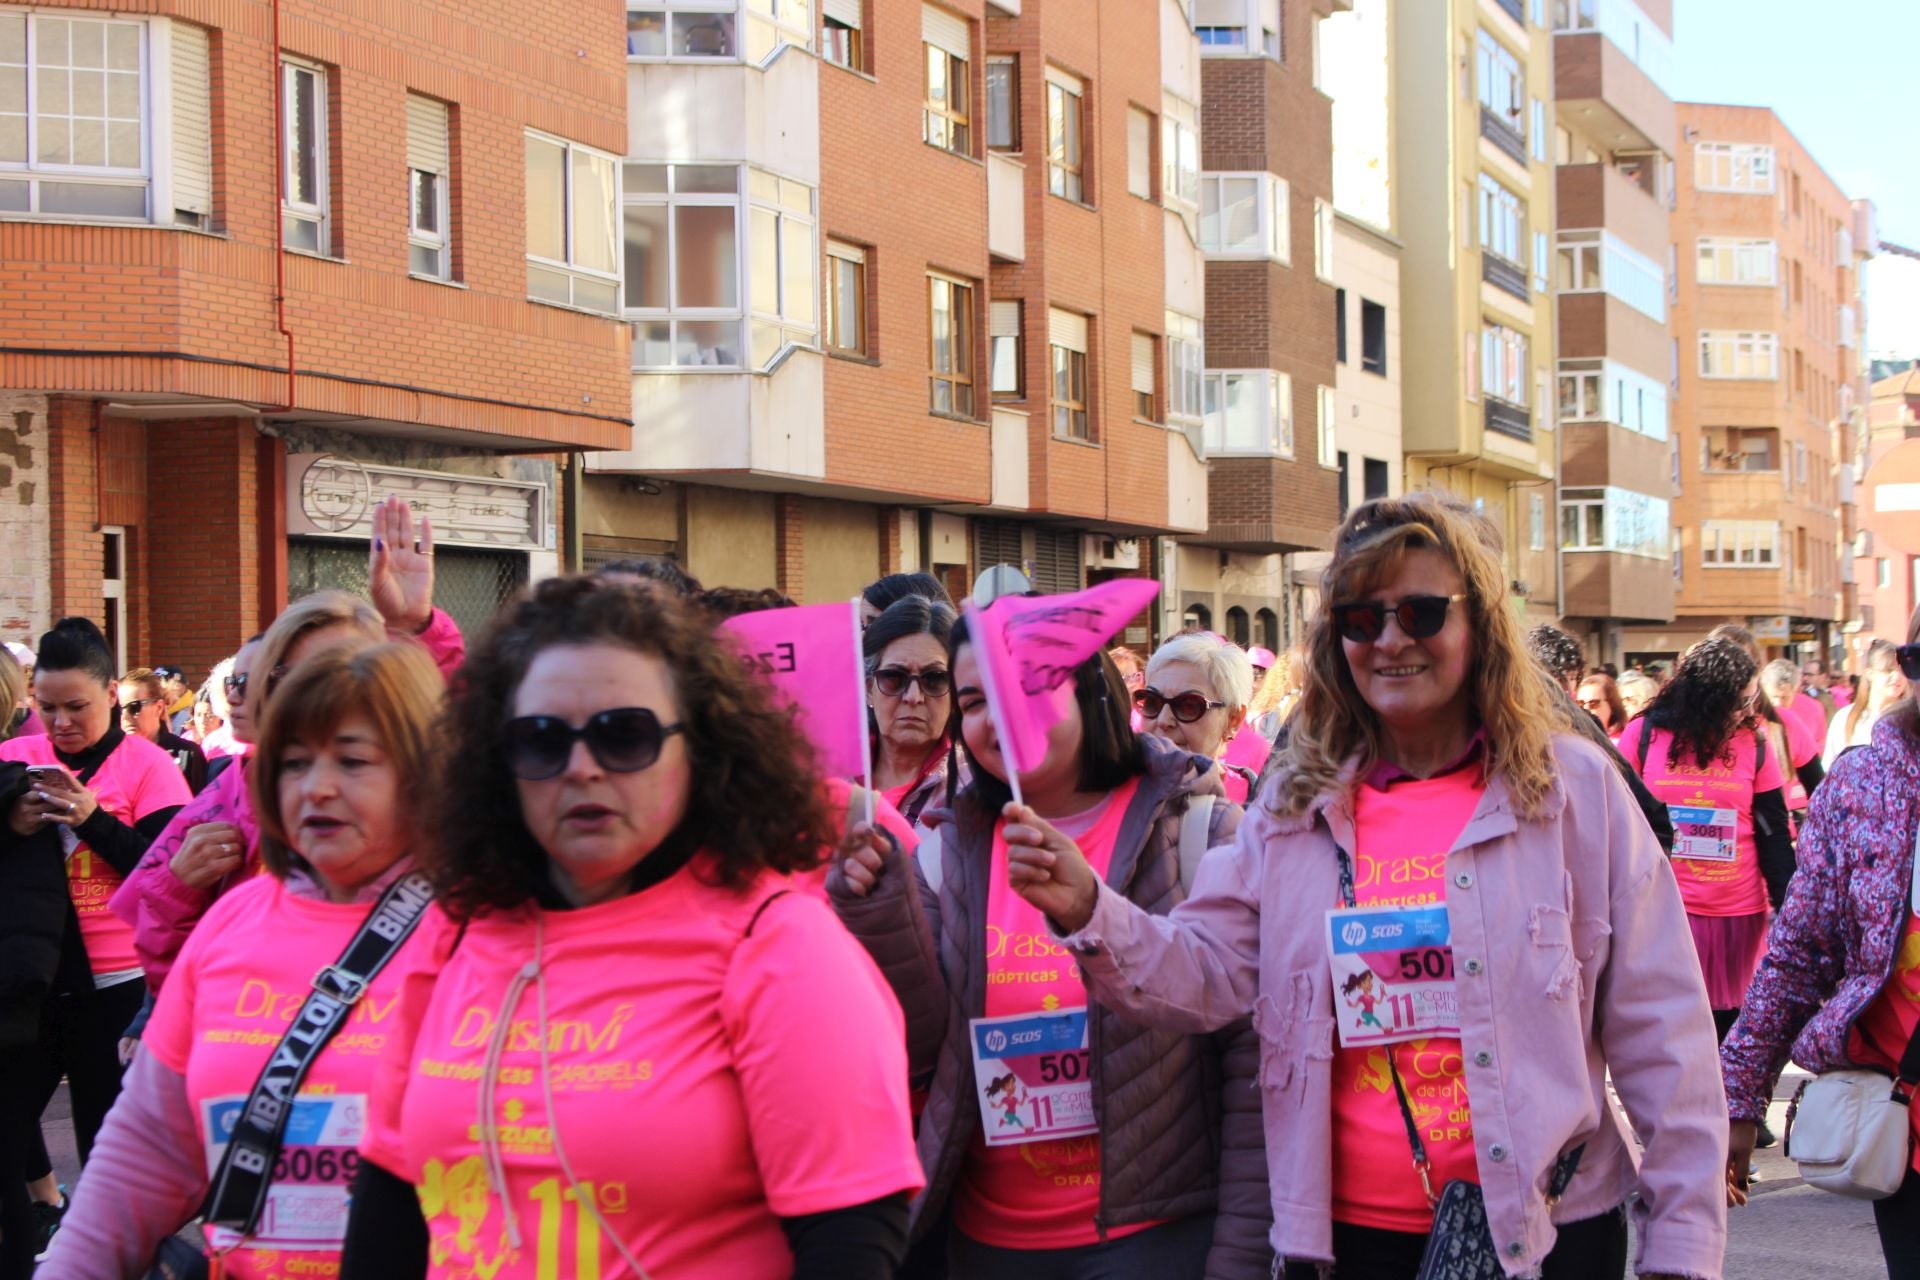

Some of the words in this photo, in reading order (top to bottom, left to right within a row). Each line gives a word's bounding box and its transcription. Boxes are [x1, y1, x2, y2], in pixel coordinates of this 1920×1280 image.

[1690, 824, 1724, 838] 3081
[1387, 994, 1415, 1029] 11
[1028, 1096, 1054, 1128] 11
